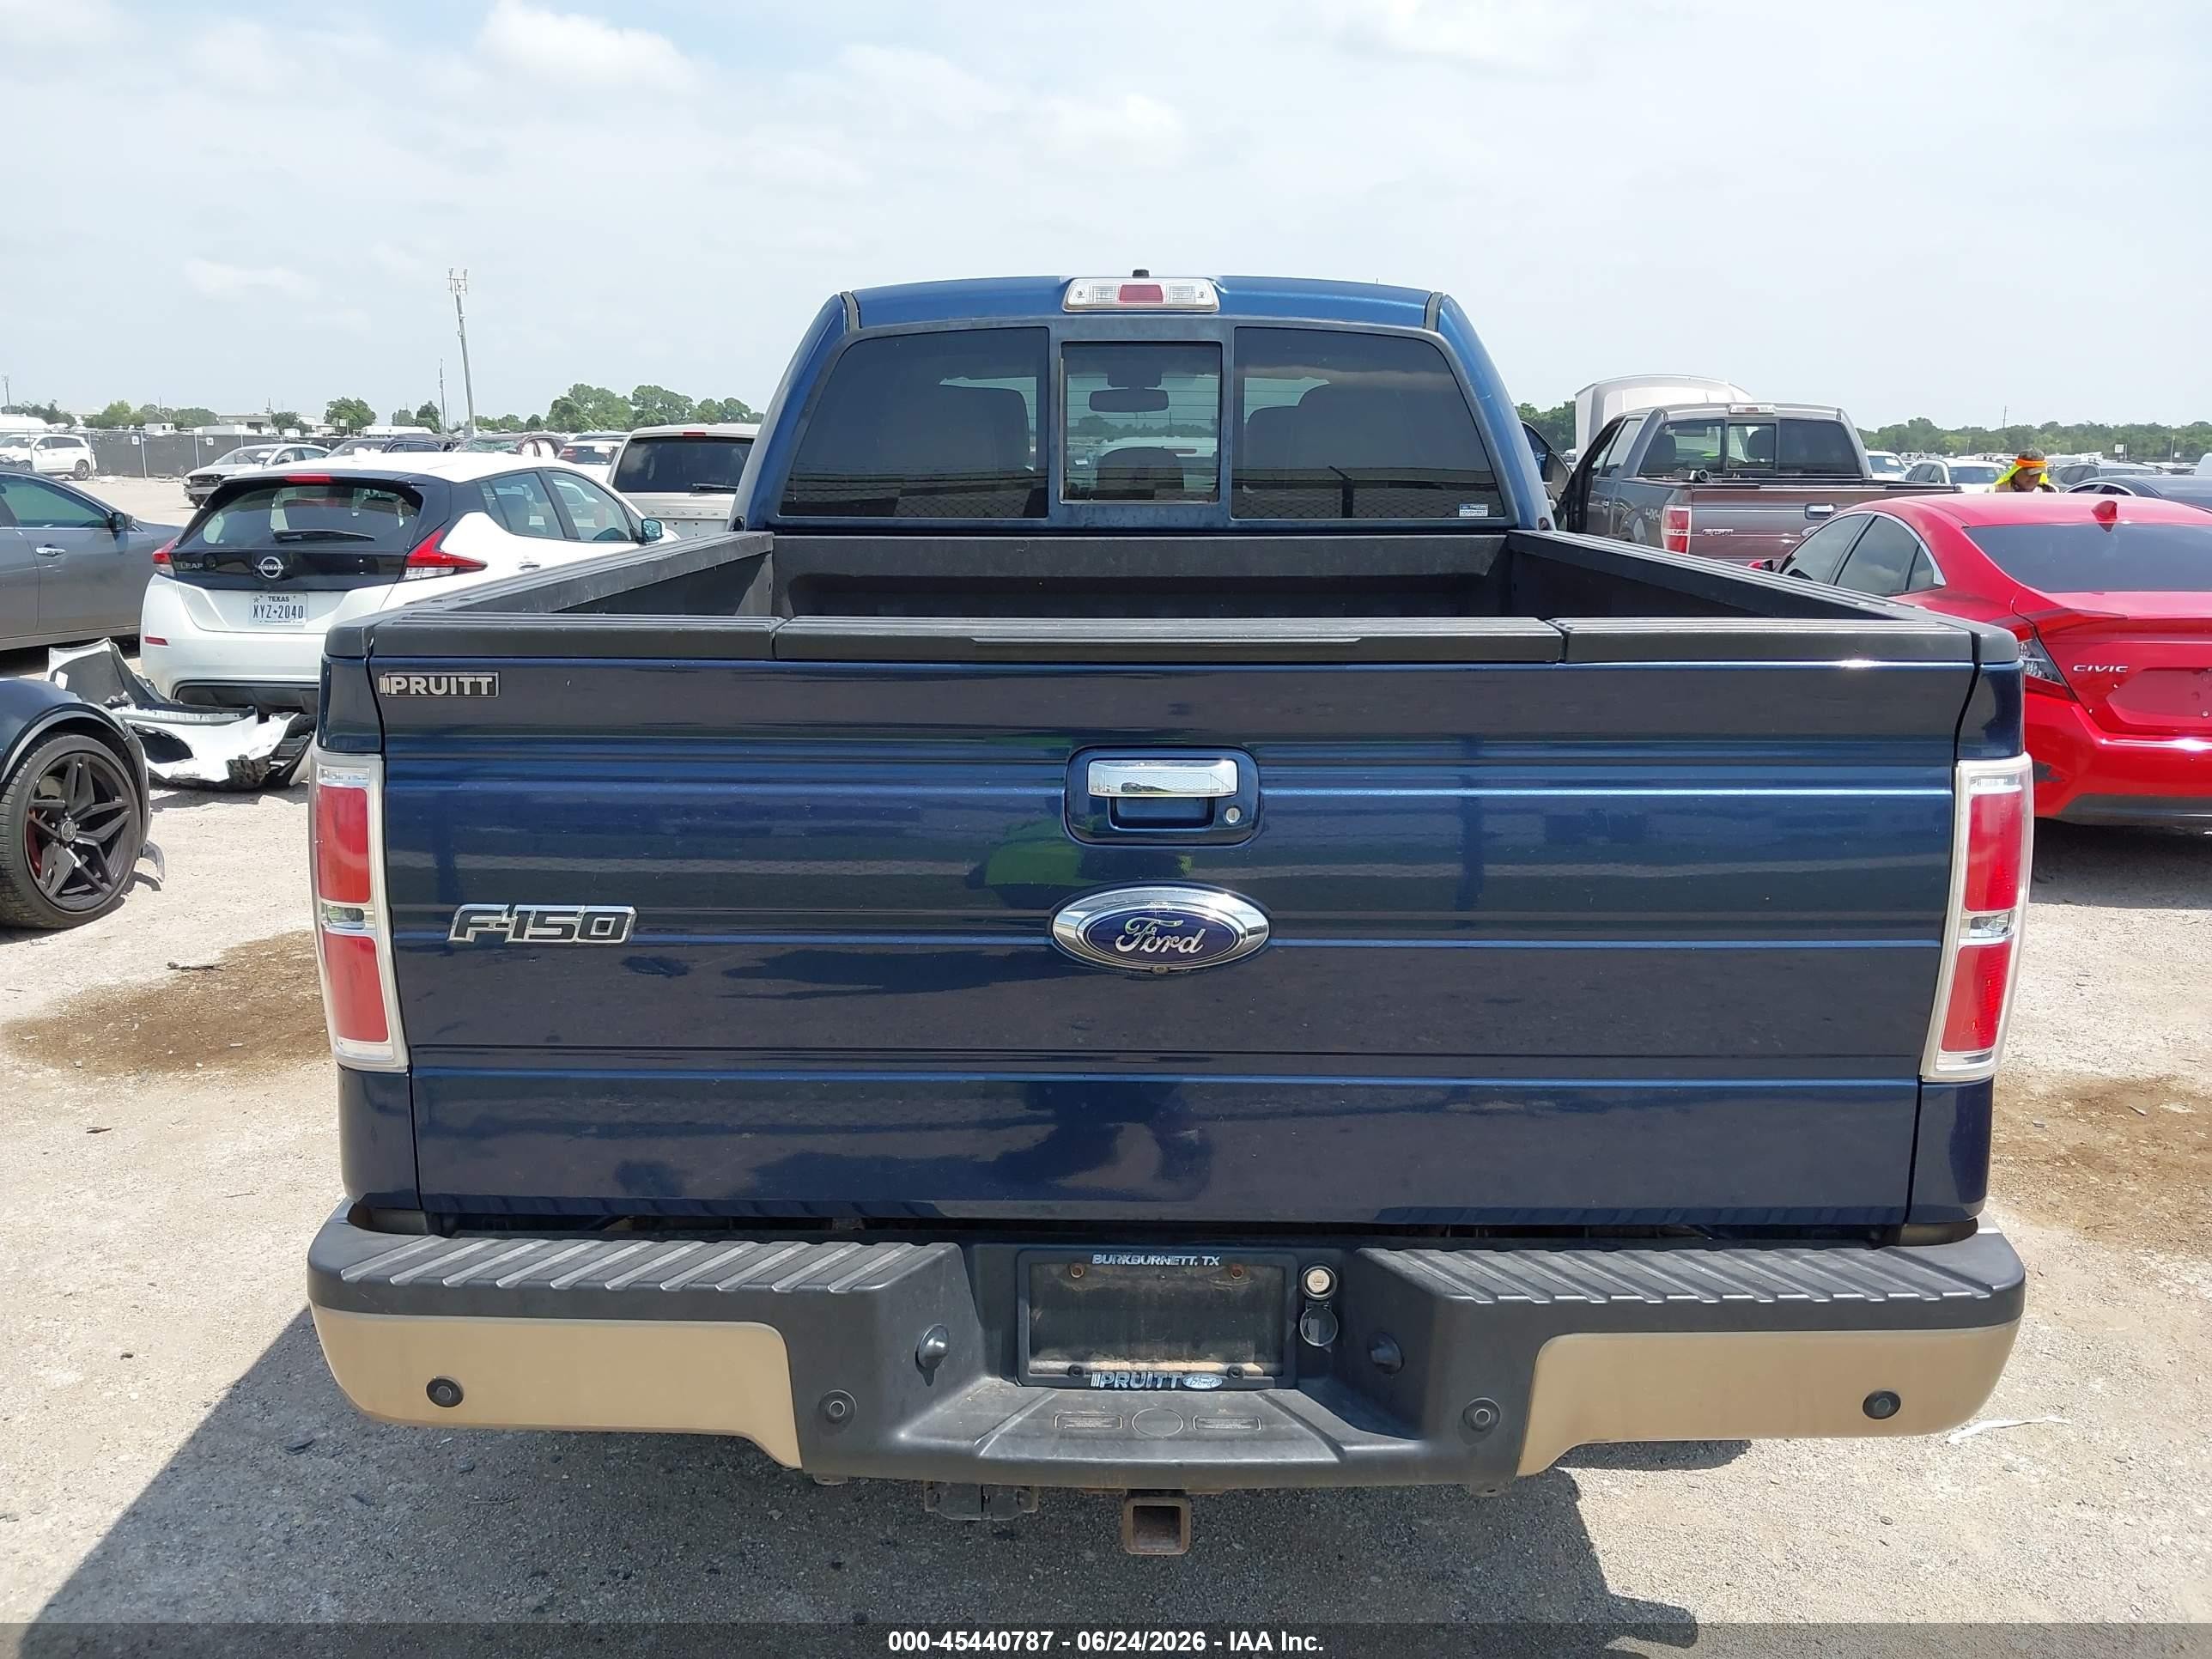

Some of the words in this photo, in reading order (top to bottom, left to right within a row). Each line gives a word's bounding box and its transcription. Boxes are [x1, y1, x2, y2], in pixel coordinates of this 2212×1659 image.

[390, 676, 493, 696] PRUITT
[447, 903, 638, 943] F-150
[1115, 916, 1206, 955] Ford
[1202, 1255, 1220, 1267] TX
[1099, 1371, 1183, 1389] PRUITT
